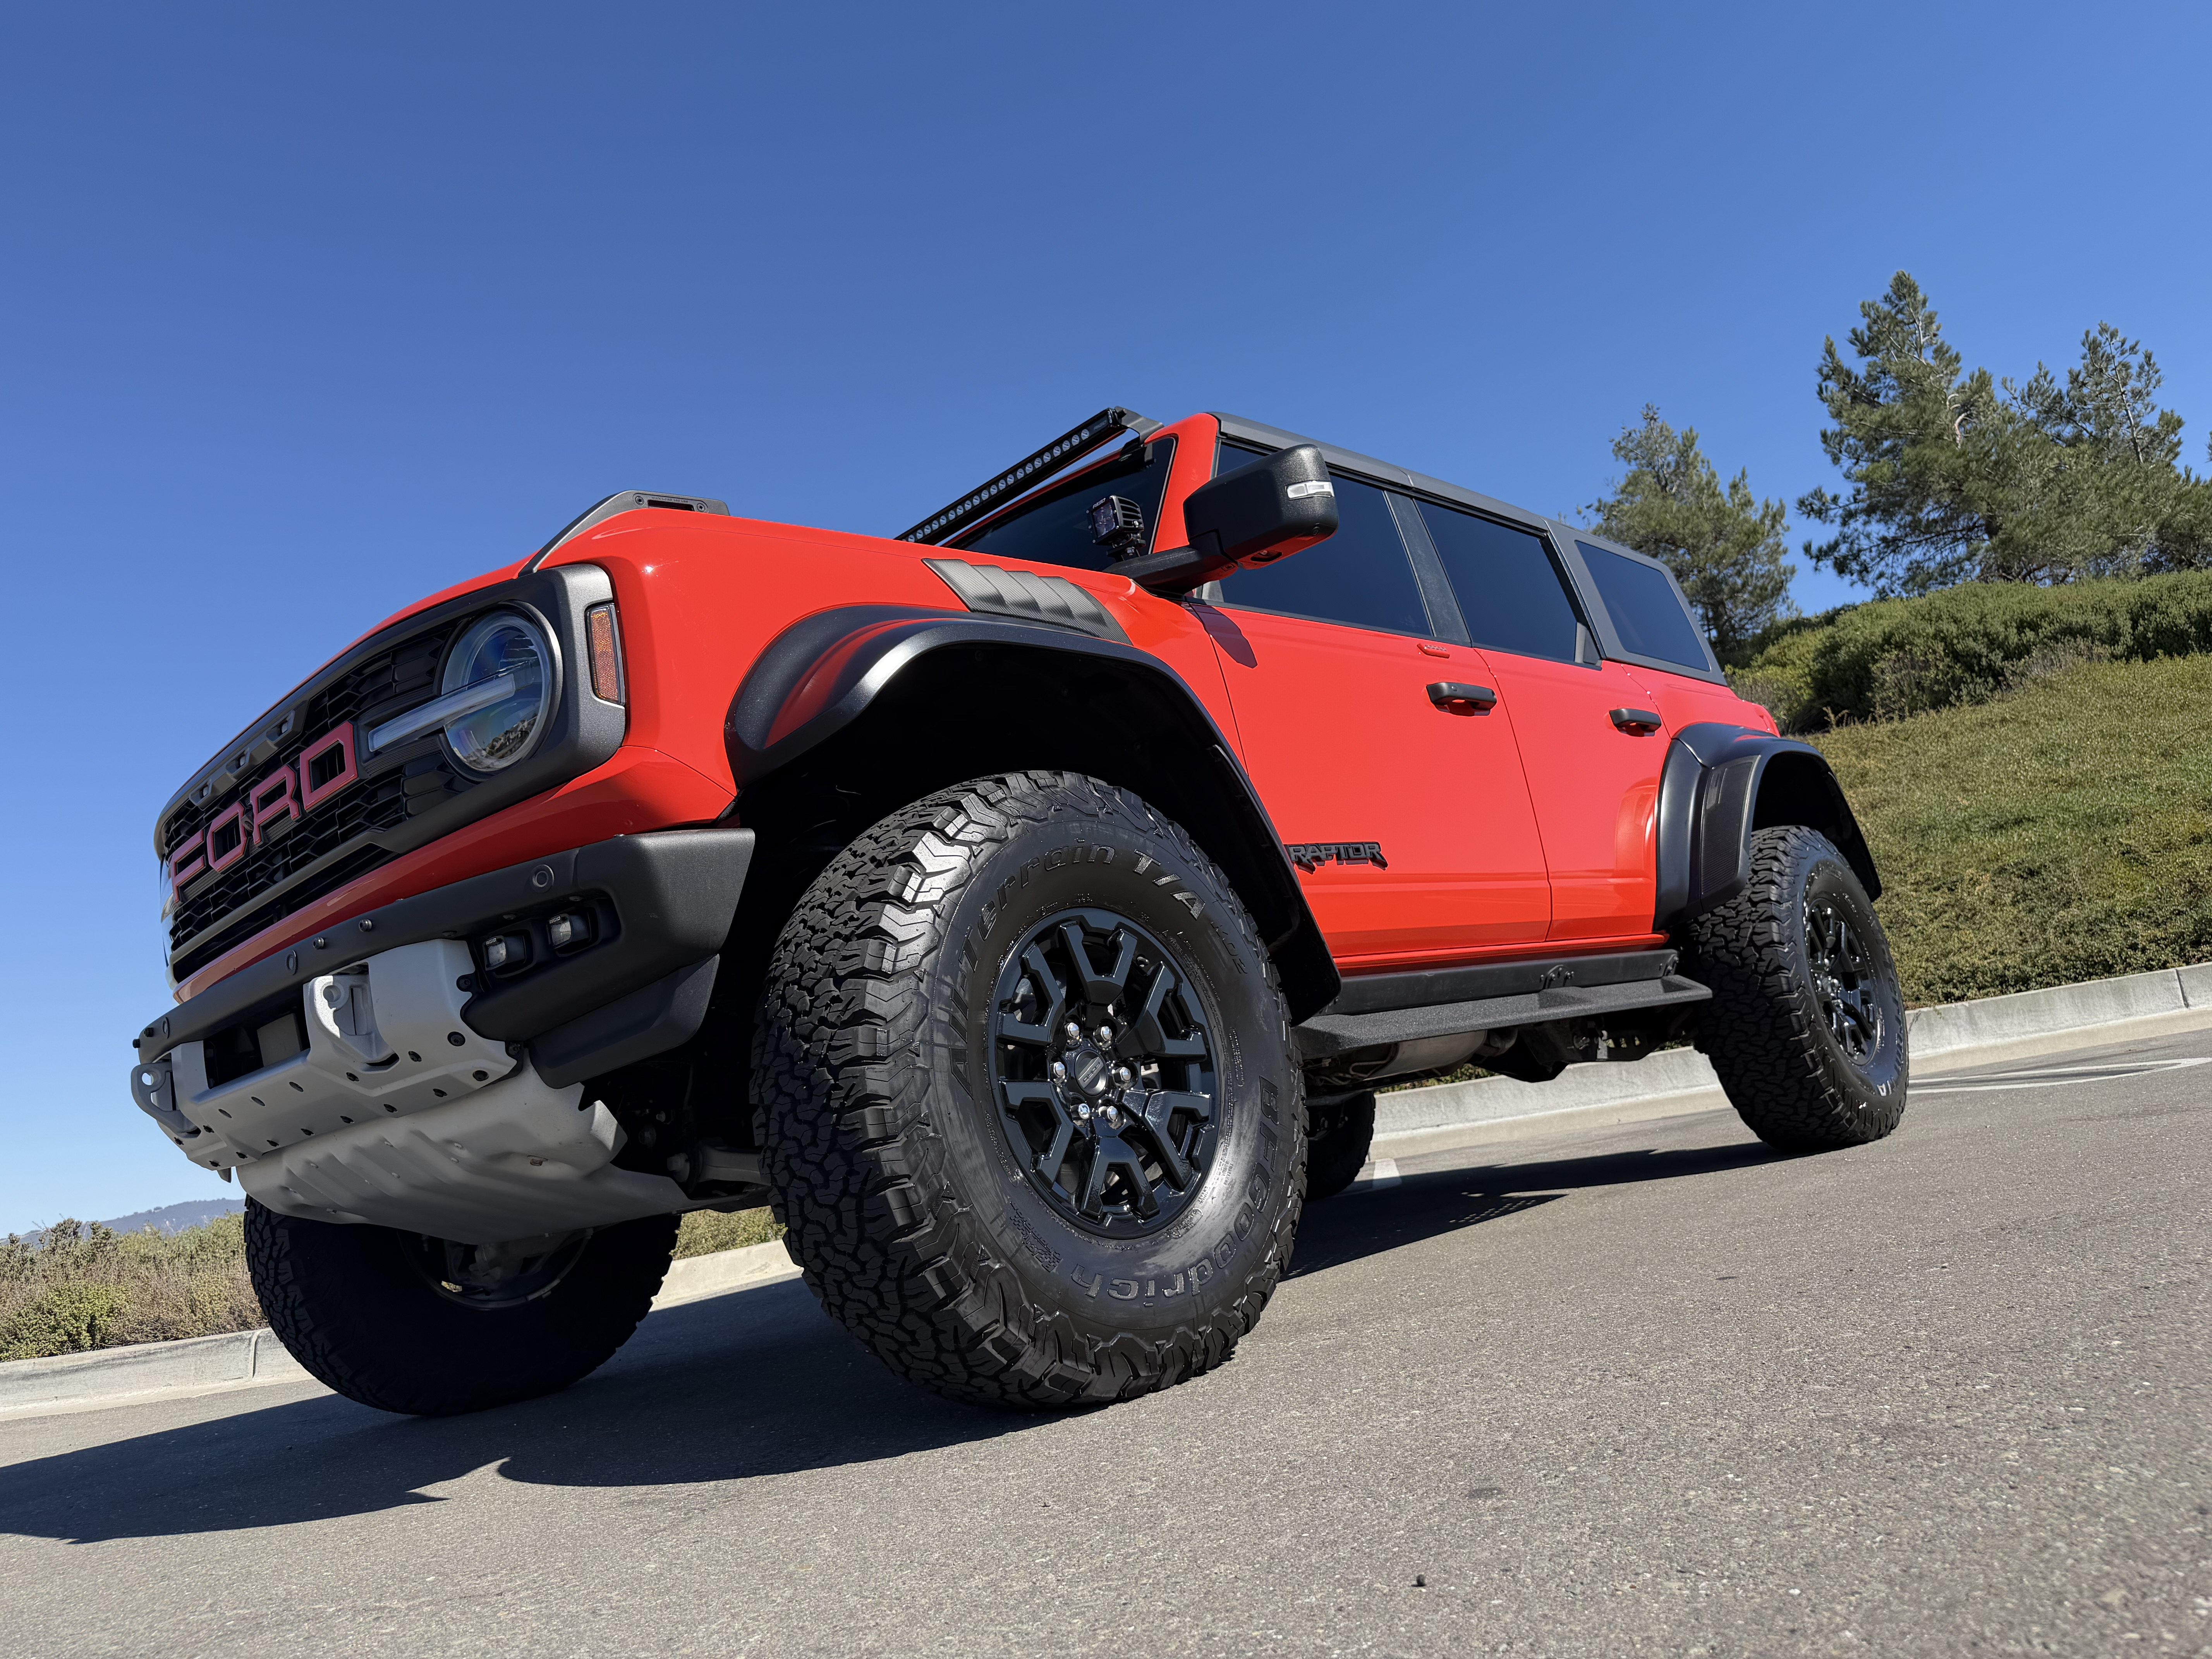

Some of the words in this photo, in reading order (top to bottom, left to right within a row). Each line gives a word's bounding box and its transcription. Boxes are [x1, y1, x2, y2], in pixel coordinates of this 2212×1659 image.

[170, 721, 359, 904] FORD
[1133, 852, 1206, 921] T/A
[1289, 842, 1388, 874] RAPTOR
[1082, 1062, 1101, 1082] FORD
[1072, 1075, 1280, 1301] BFGoodrich
